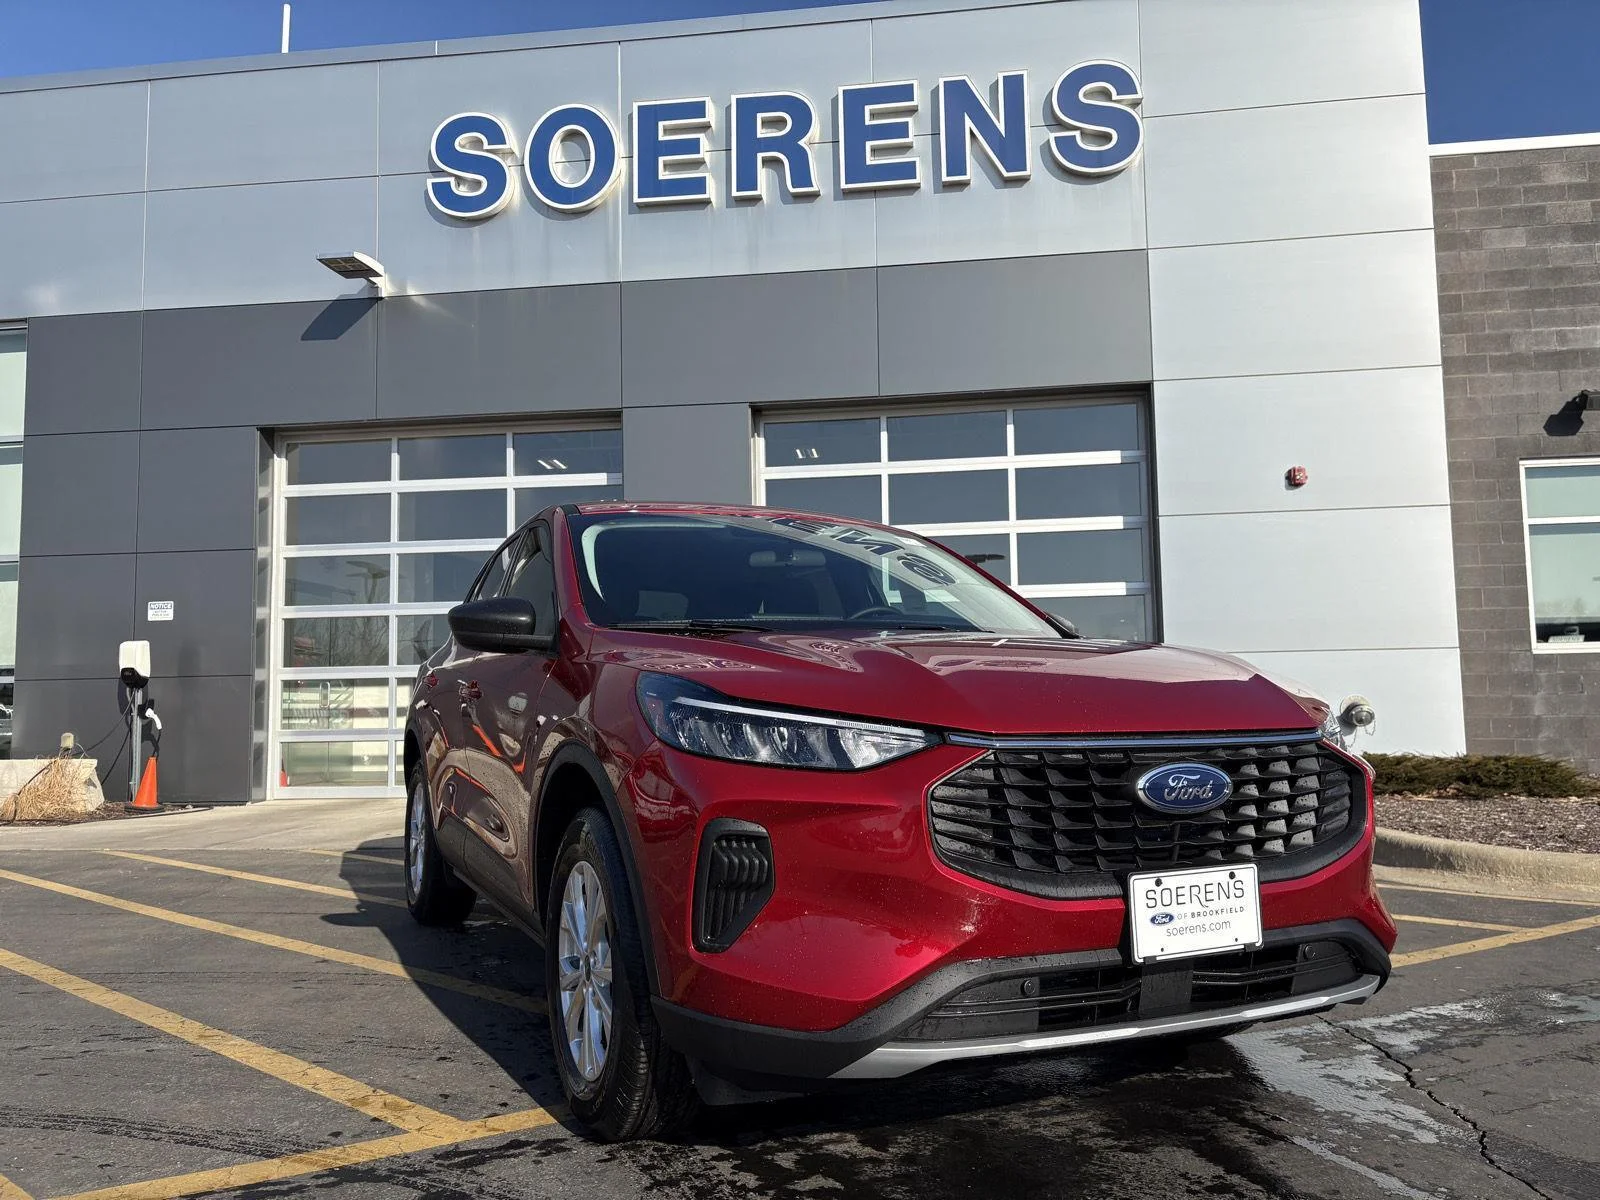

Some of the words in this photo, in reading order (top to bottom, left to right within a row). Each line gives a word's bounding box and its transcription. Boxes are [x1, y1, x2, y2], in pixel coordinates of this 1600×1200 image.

[426, 59, 1143, 220] SOERENS
[1164, 774, 1214, 801] Ford
[1145, 879, 1245, 909] SOERENS
[1177, 912, 1188, 920] OF
[1190, 906, 1245, 919] BROOKFIELD
[1166, 920, 1232, 937] soerens.com
